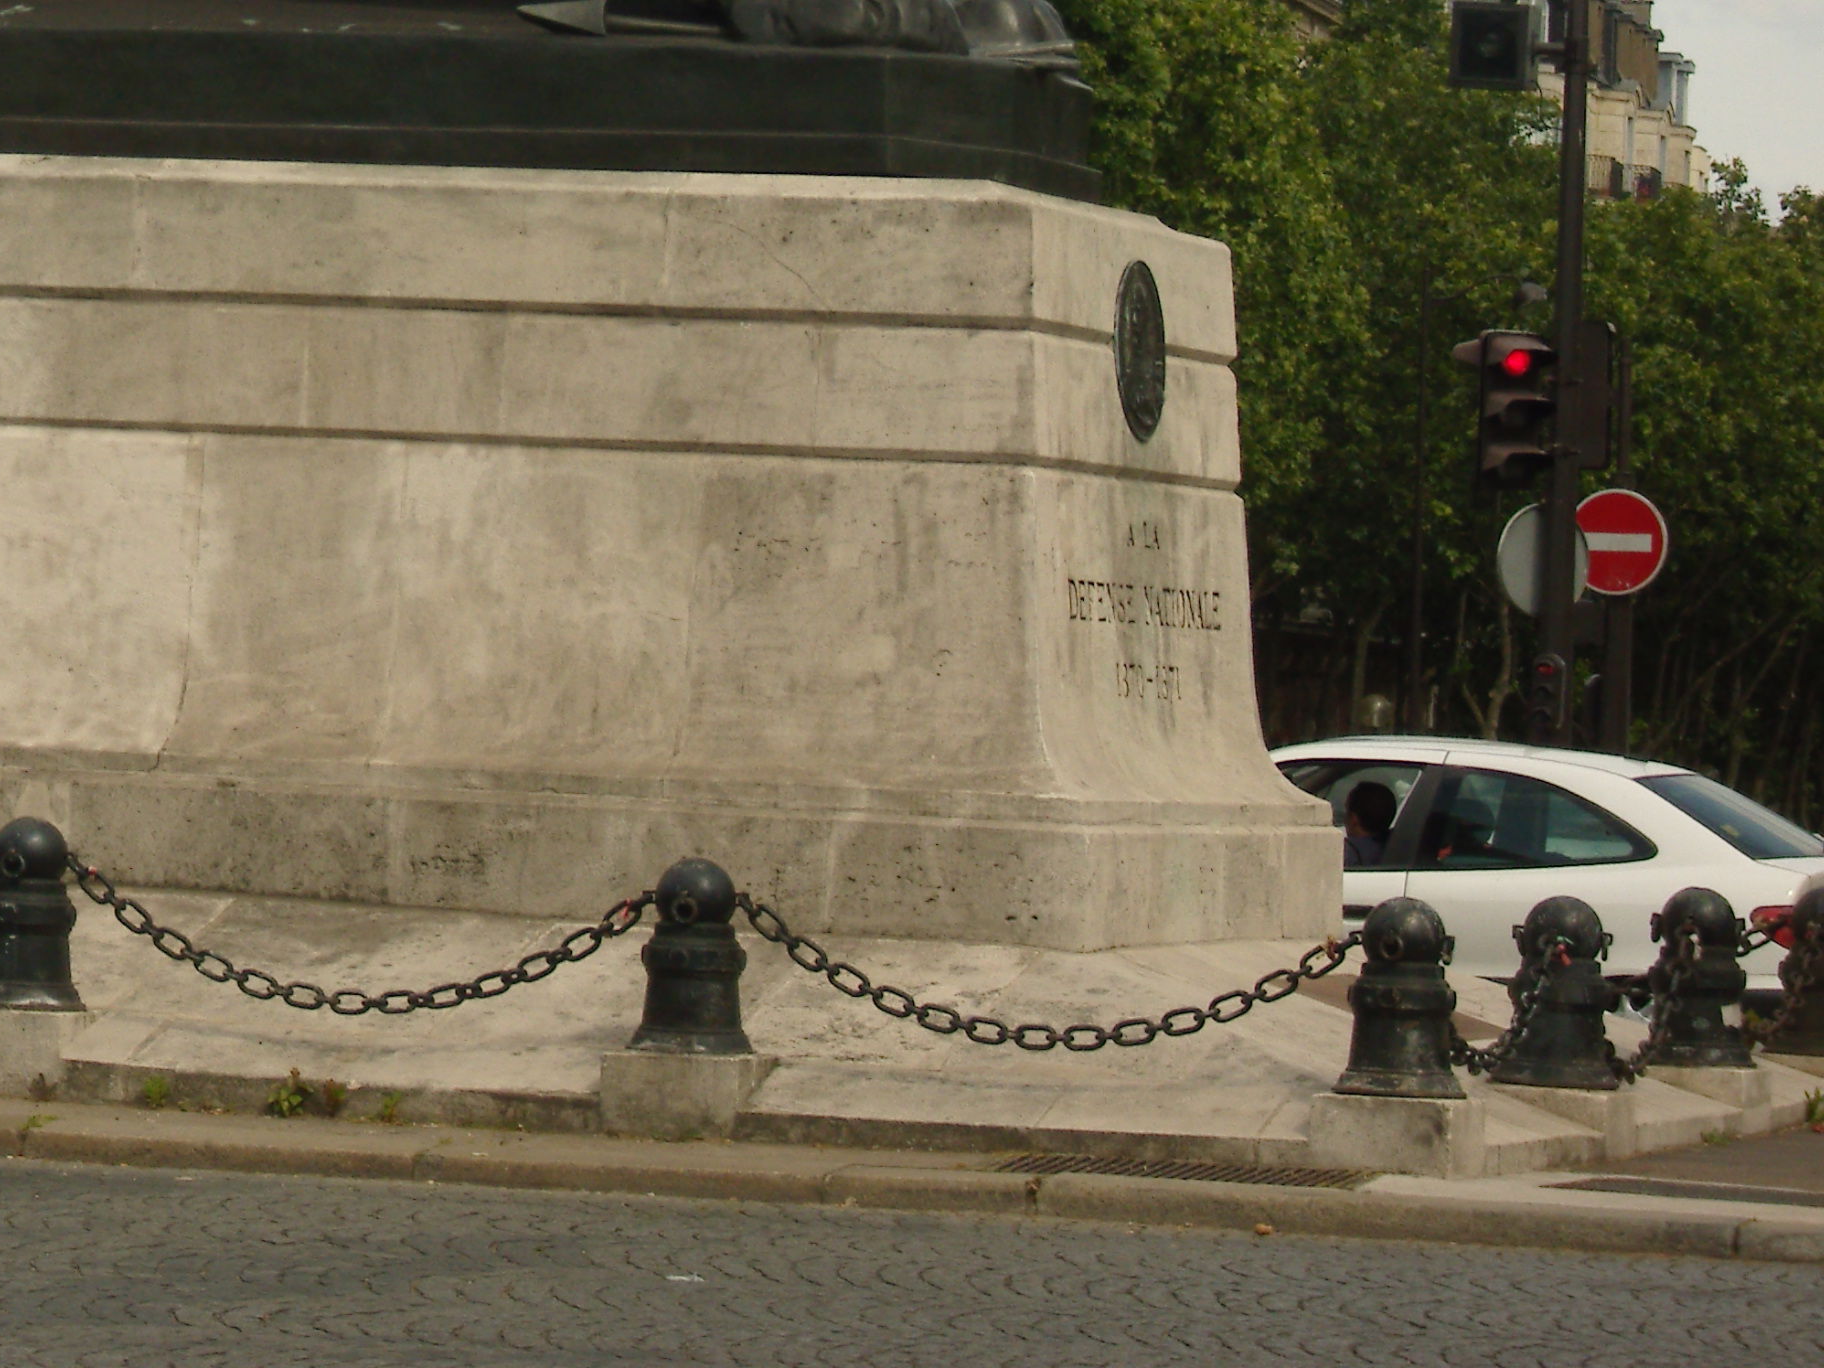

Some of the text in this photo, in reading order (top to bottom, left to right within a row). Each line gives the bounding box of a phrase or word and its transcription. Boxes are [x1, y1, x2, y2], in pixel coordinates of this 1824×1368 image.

[1126, 522, 1160, 549] A LA
[1068, 579, 1221, 630] DEFENSE NATIONALE
[1116, 663, 1181, 699] 1870-1871
